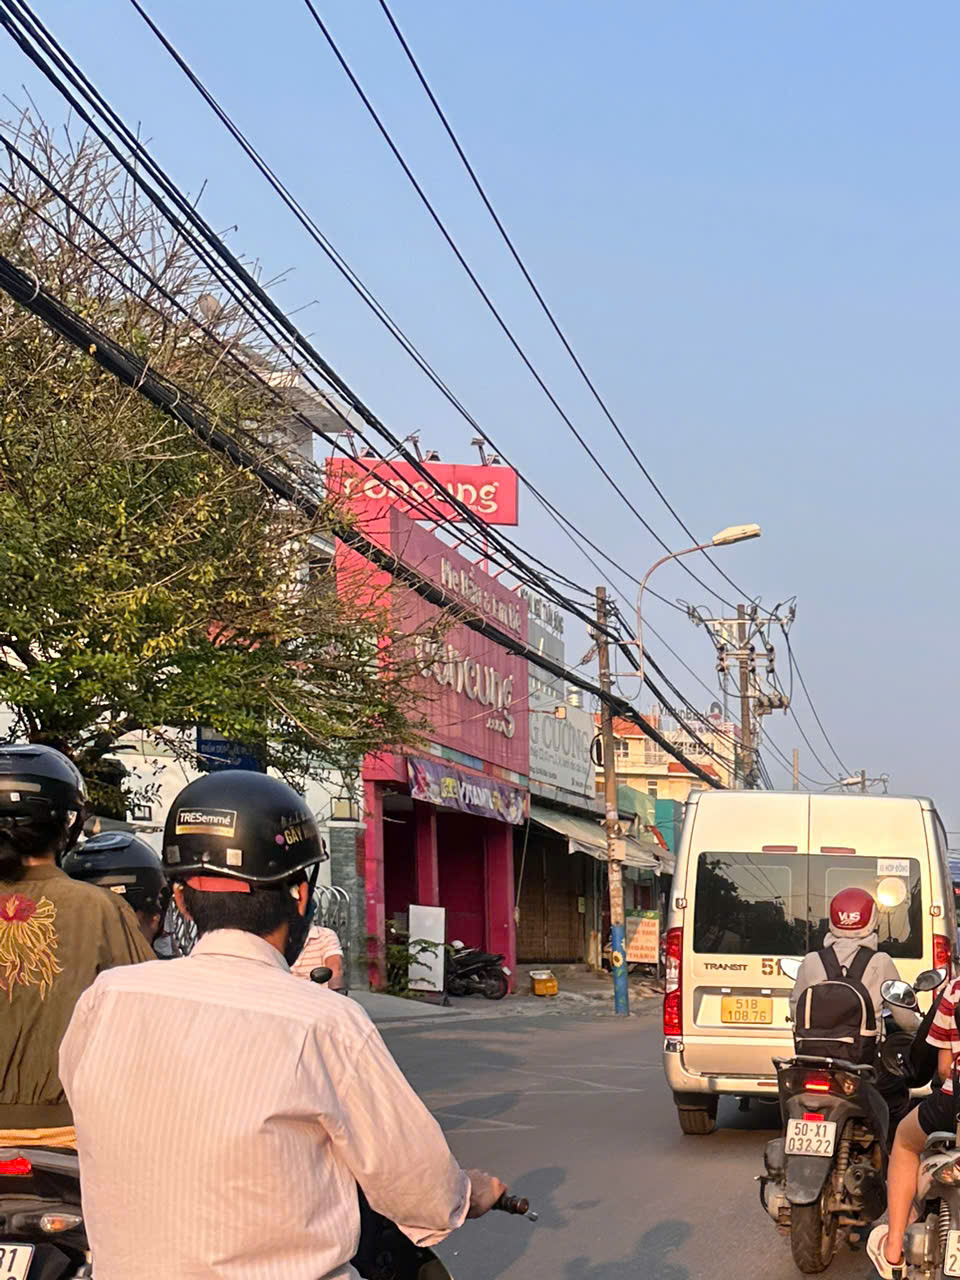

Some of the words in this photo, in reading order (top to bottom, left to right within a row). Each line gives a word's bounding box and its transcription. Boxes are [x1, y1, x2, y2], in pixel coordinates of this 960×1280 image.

[180, 812, 231, 825] TRESemmé
[704, 962, 749, 972] TRANSIT
[761, 957, 786, 976] 51
[794, 1122, 828, 1138] 50-X1
